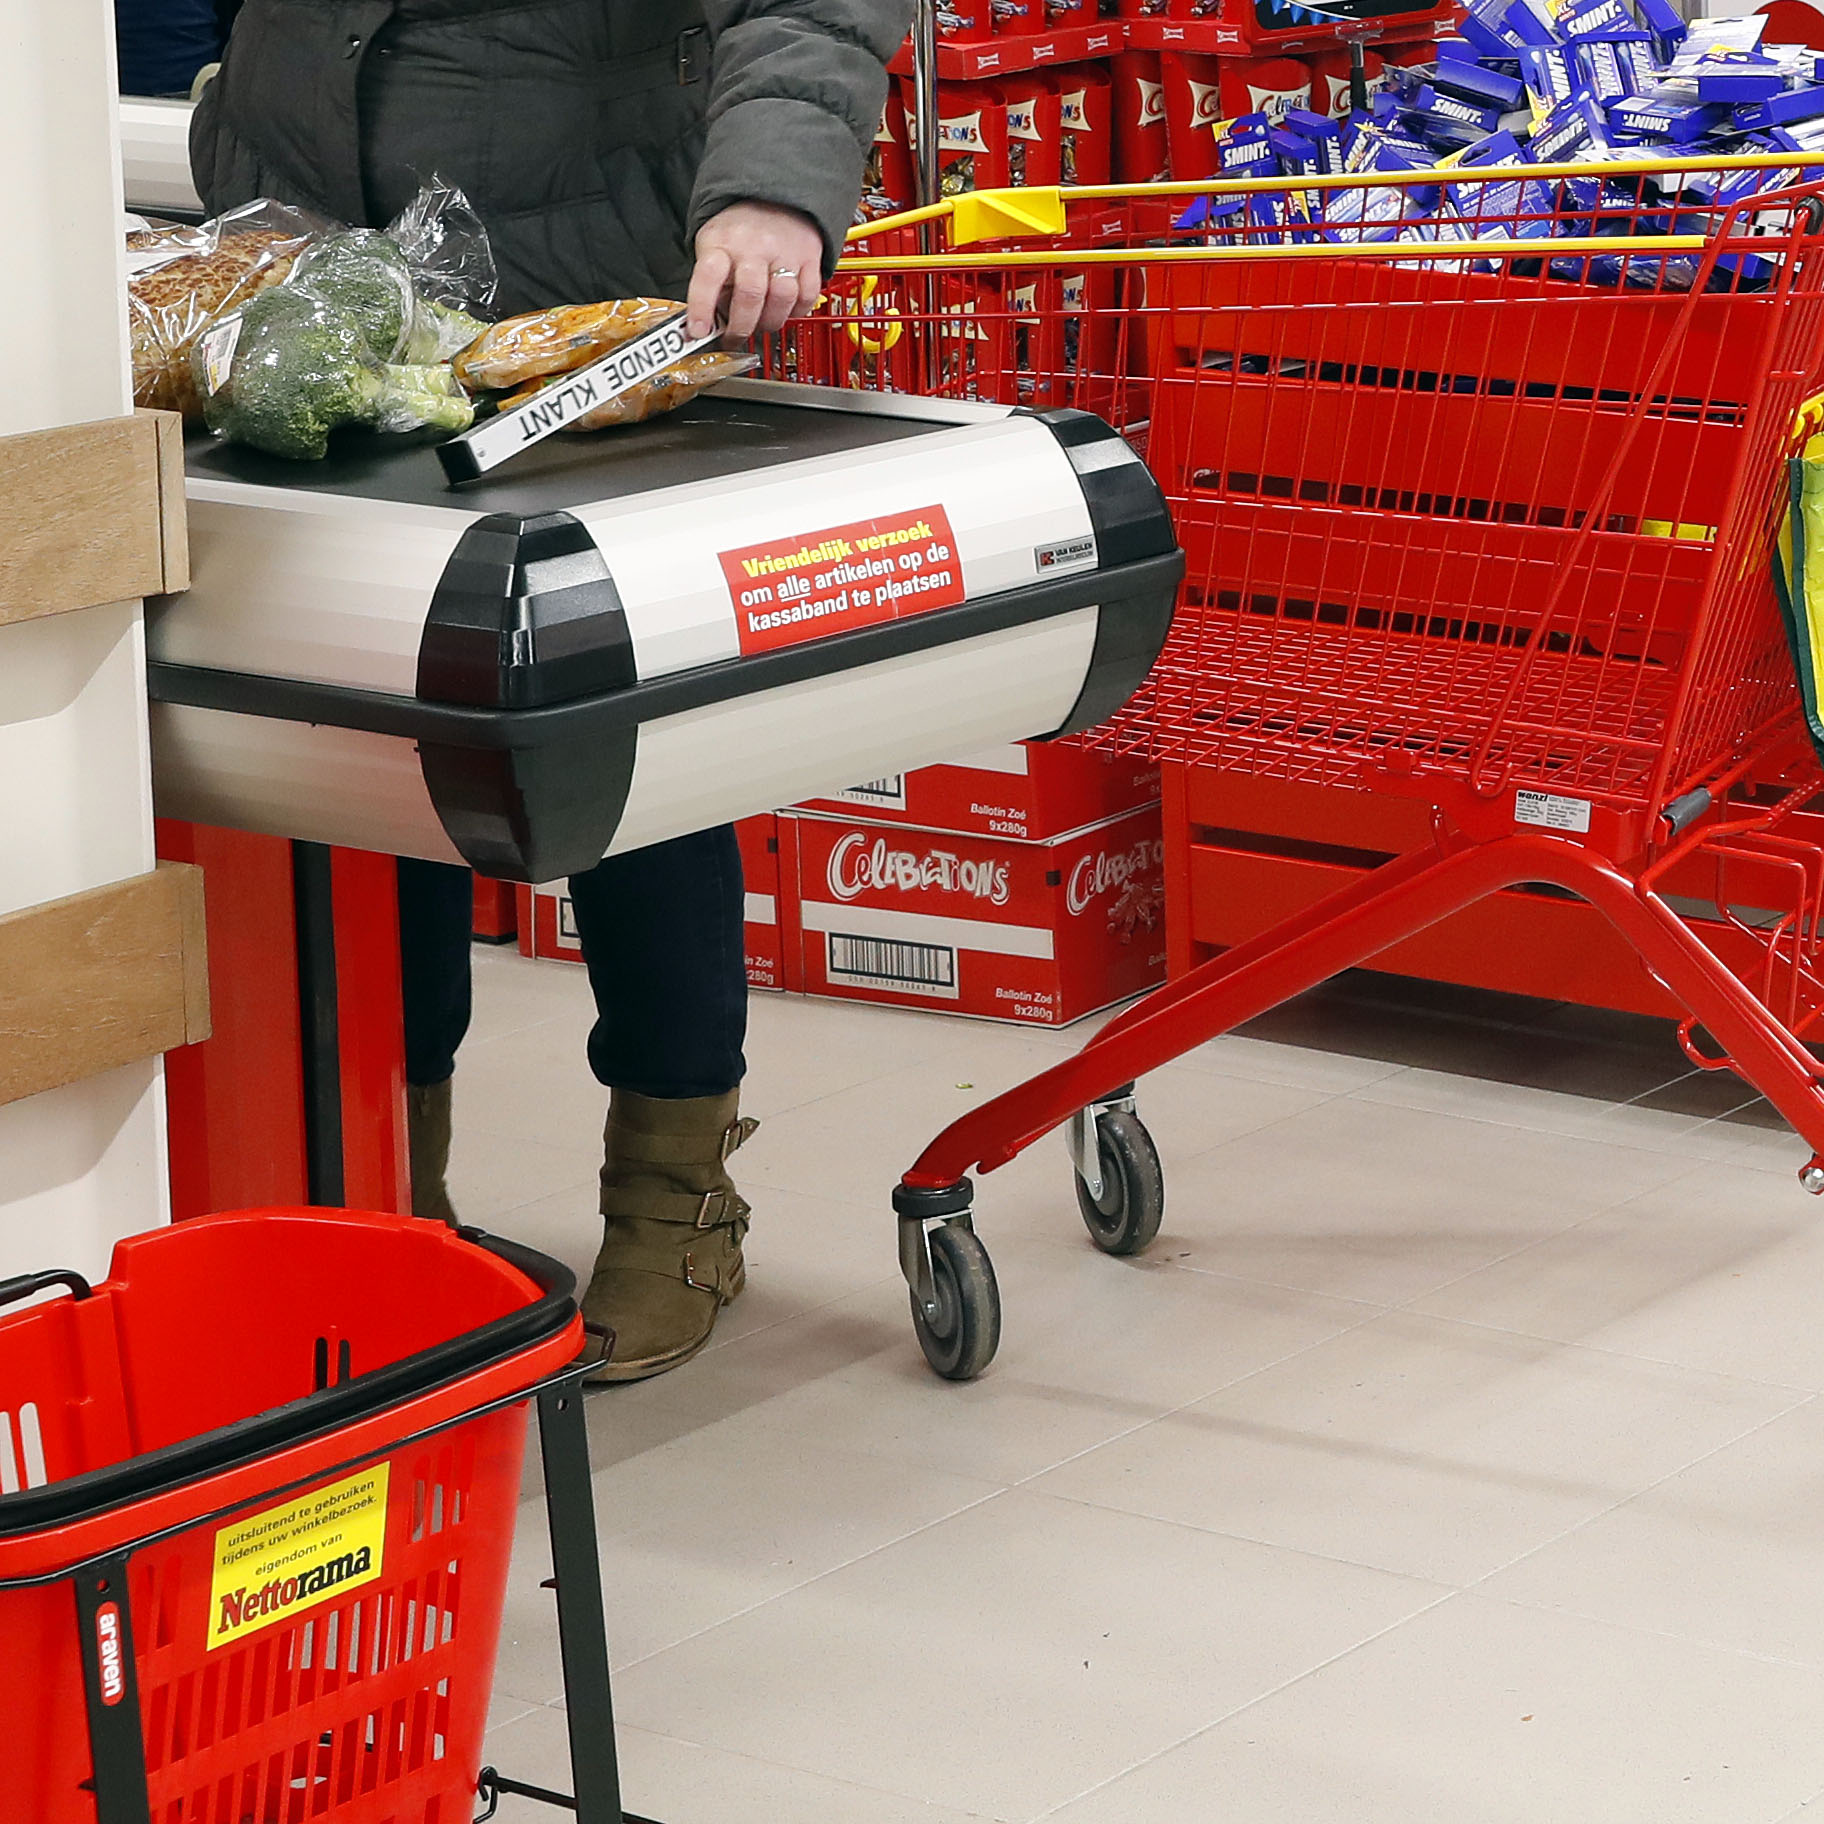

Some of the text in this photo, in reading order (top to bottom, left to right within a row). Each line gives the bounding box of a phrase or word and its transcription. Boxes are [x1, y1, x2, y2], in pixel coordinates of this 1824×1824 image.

[519, 328, 686, 442] GENDE KLANT
[740, 542, 950, 608] om alle artikelen op de
[742, 520, 933, 579] Vriendelijk verzoek
[748, 570, 952, 633] kassaband te plaatsen
[970, 802, 1027, 821] Ballotin Zoé
[988, 819, 1028, 838] 9x280g
[755, 956, 774, 969] Zoé
[995, 987, 1053, 1005] Ballotin Zoé
[1013, 1003, 1053, 1022] 9x280g
[221, 1495, 377, 1566] tijdens uw winkelbezoek.
[227, 1479, 375, 1548] uitsluitend te gebruiken
[255, 1532, 343, 1576] eigendom van
[217, 1545, 372, 1635] Nettorama
[99, 1612, 122, 1698] araven
